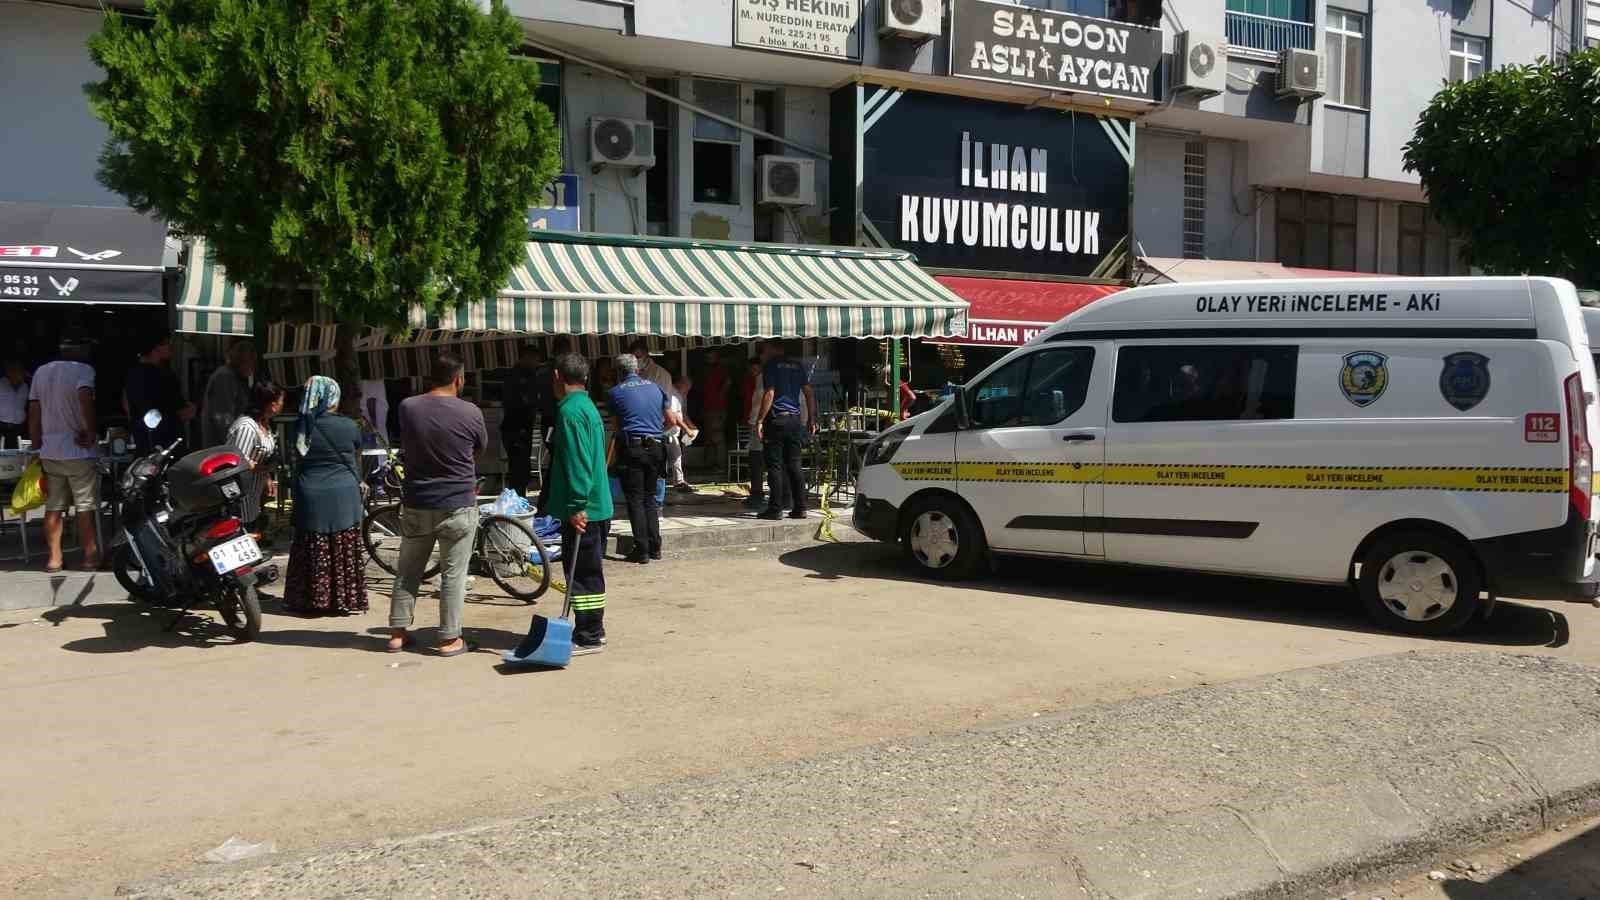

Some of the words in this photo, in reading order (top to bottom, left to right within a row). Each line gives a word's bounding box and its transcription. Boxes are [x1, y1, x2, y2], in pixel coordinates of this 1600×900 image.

[816, 20, 856, 35] ERATAK
[993, 10, 1129, 54] SALOON
[971, 41, 1035, 78] ASLI
[1059, 54, 1150, 94] AYCAN
[961, 131, 1048, 193] İLHAN
[901, 194, 1100, 255] KUYUMCULUK
[3, 274, 20, 284] 95
[23, 275, 39, 285] 31
[23, 287, 40, 297] 07
[1196, 295, 1242, 312] OLAY
[972, 323, 1018, 342] İLHAN
[1531, 416, 1555, 430] 112
